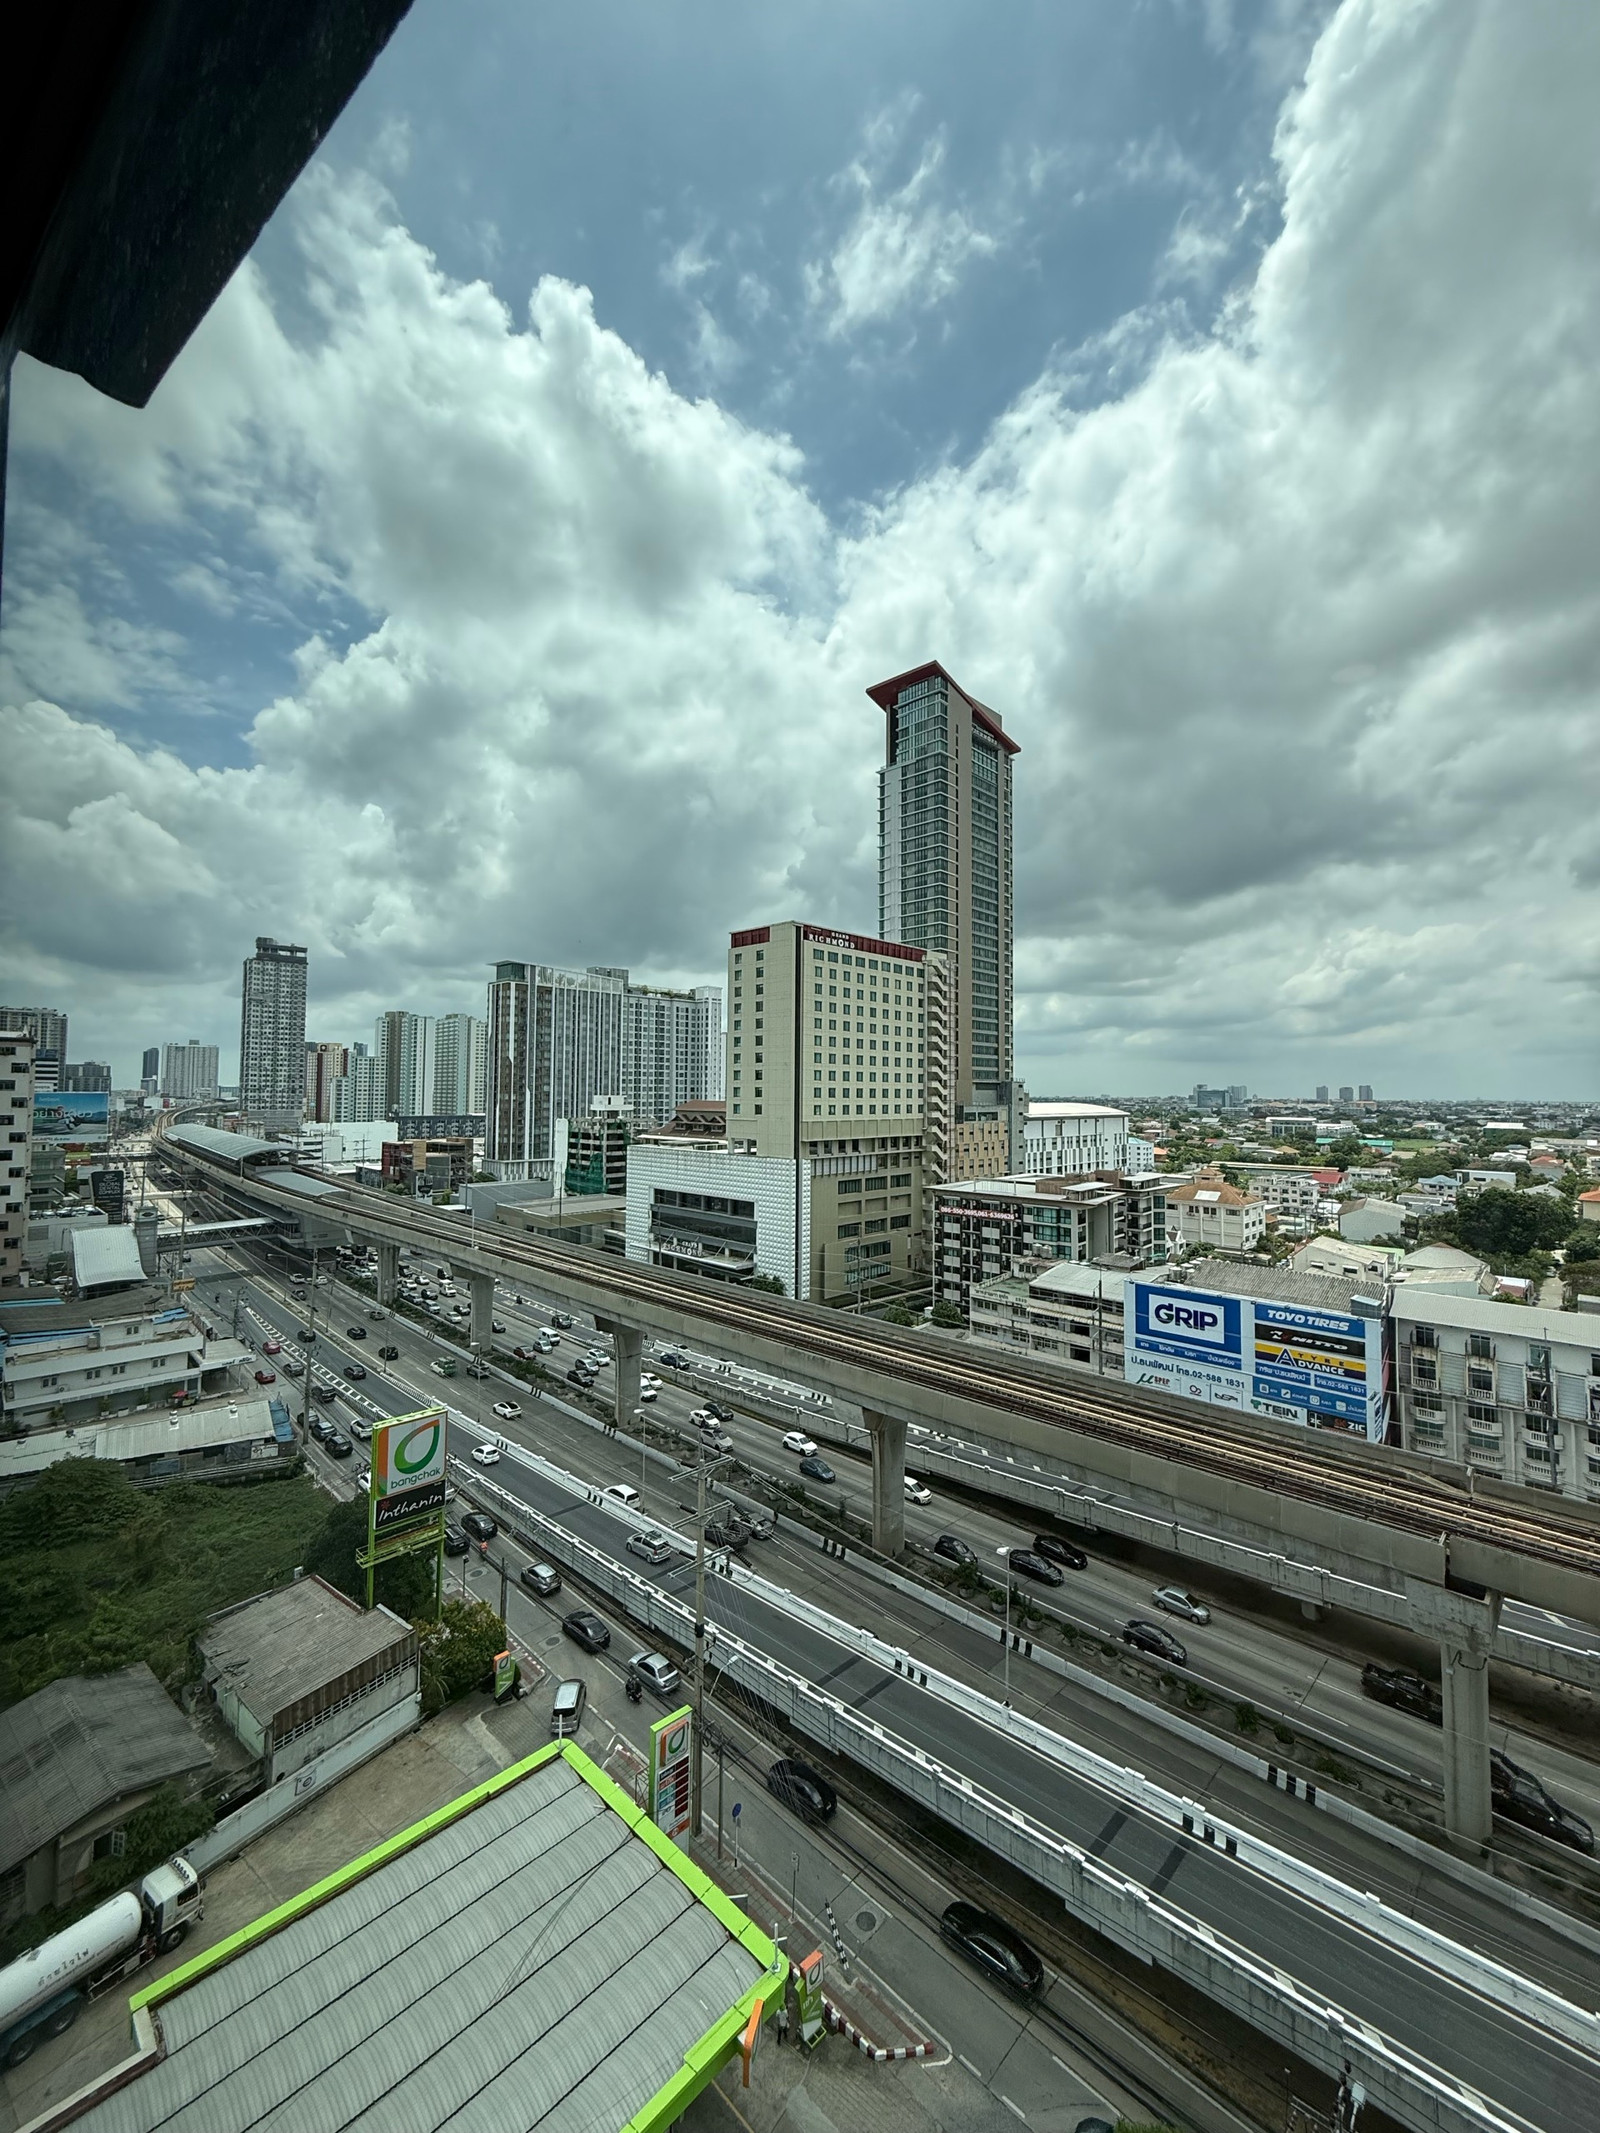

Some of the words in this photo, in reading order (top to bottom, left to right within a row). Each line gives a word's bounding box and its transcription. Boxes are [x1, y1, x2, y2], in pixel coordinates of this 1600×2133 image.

[808, 933, 856, 949] RICHMOND
[831, 932, 850, 940] GRAND
[1154, 1302, 1218, 1331] GRIP
[1267, 1309, 1307, 1324] TOYO
[1307, 1316, 1350, 1331] TIRES
[1291, 1336, 1348, 1350] NITTO
[1225, 1378, 1245, 1389] 1831
[1350, 1385, 1365, 1394] 1831
[1262, 1402, 1299, 1419] TEIN
[1347, 1421, 1366, 1433] ZIC
[391, 1467, 441, 1489] bangchak
[378, 1494, 443, 1522] Inthanin
